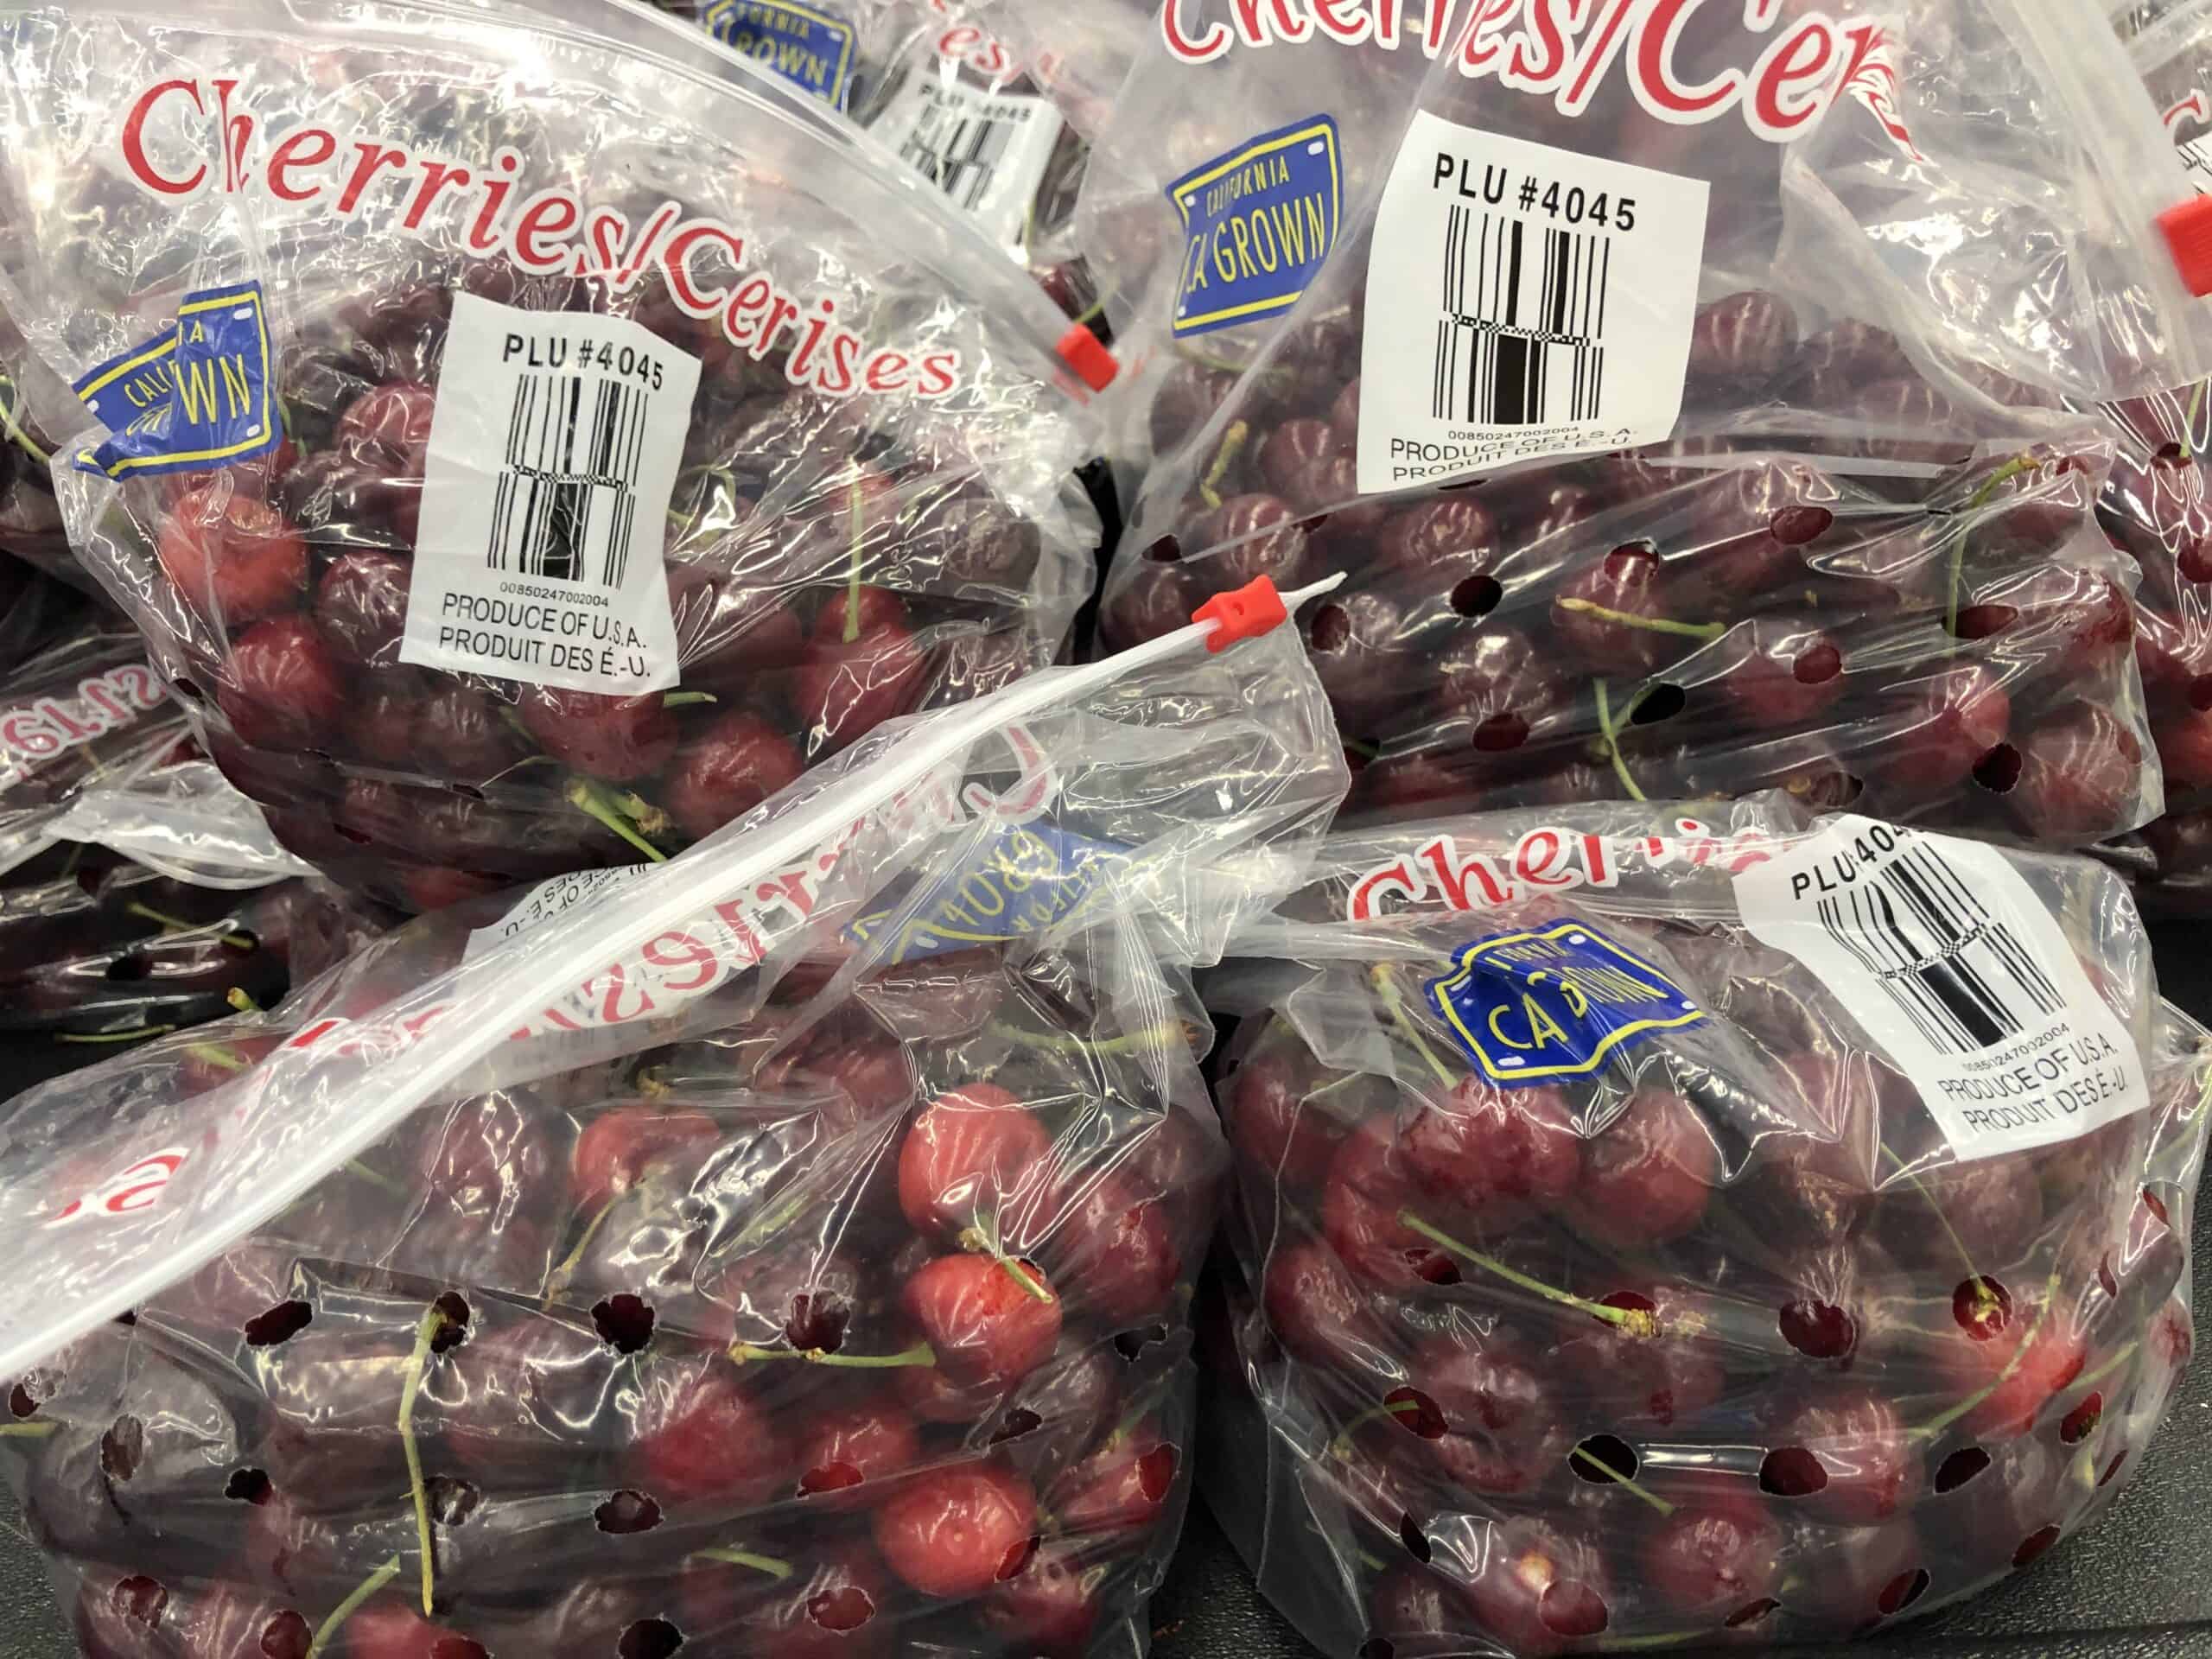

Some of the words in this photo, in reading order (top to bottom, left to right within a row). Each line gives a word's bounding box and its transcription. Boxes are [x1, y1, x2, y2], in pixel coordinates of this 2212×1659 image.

[1206, 155, 1289, 217] CALIFORNIA
[1433, 152, 1507, 204] PLU
[1518, 175, 1636, 231] #4045
[120, 76, 957, 394] Cherries/Cerises
[1213, 192, 1325, 283] GROWN
[503, 334, 567, 368] PLU
[579, 339, 664, 391] #4045
[1390, 437, 1515, 461] PRODUCE
[1522, 435, 1560, 448] OF
[1393, 450, 1509, 481] PRODUIT
[442, 593, 556, 632] PRODUCE
[561, 611, 589, 636] OF
[593, 615, 647, 649] U.S.A.
[499, 582, 608, 607] 00850247002004
[439, 626, 546, 664] PRODUIT
[550, 645, 593, 672] DES
[1791, 851, 1856, 900] PLU
[1489, 992, 1568, 1049] CA
[1938, 1067, 2039, 1102] PRODUCE
[2034, 1048, 2069, 1080] OF
[1962, 1098, 2056, 1133] PRODUIT
[2053, 1078, 2099, 1114] DES
